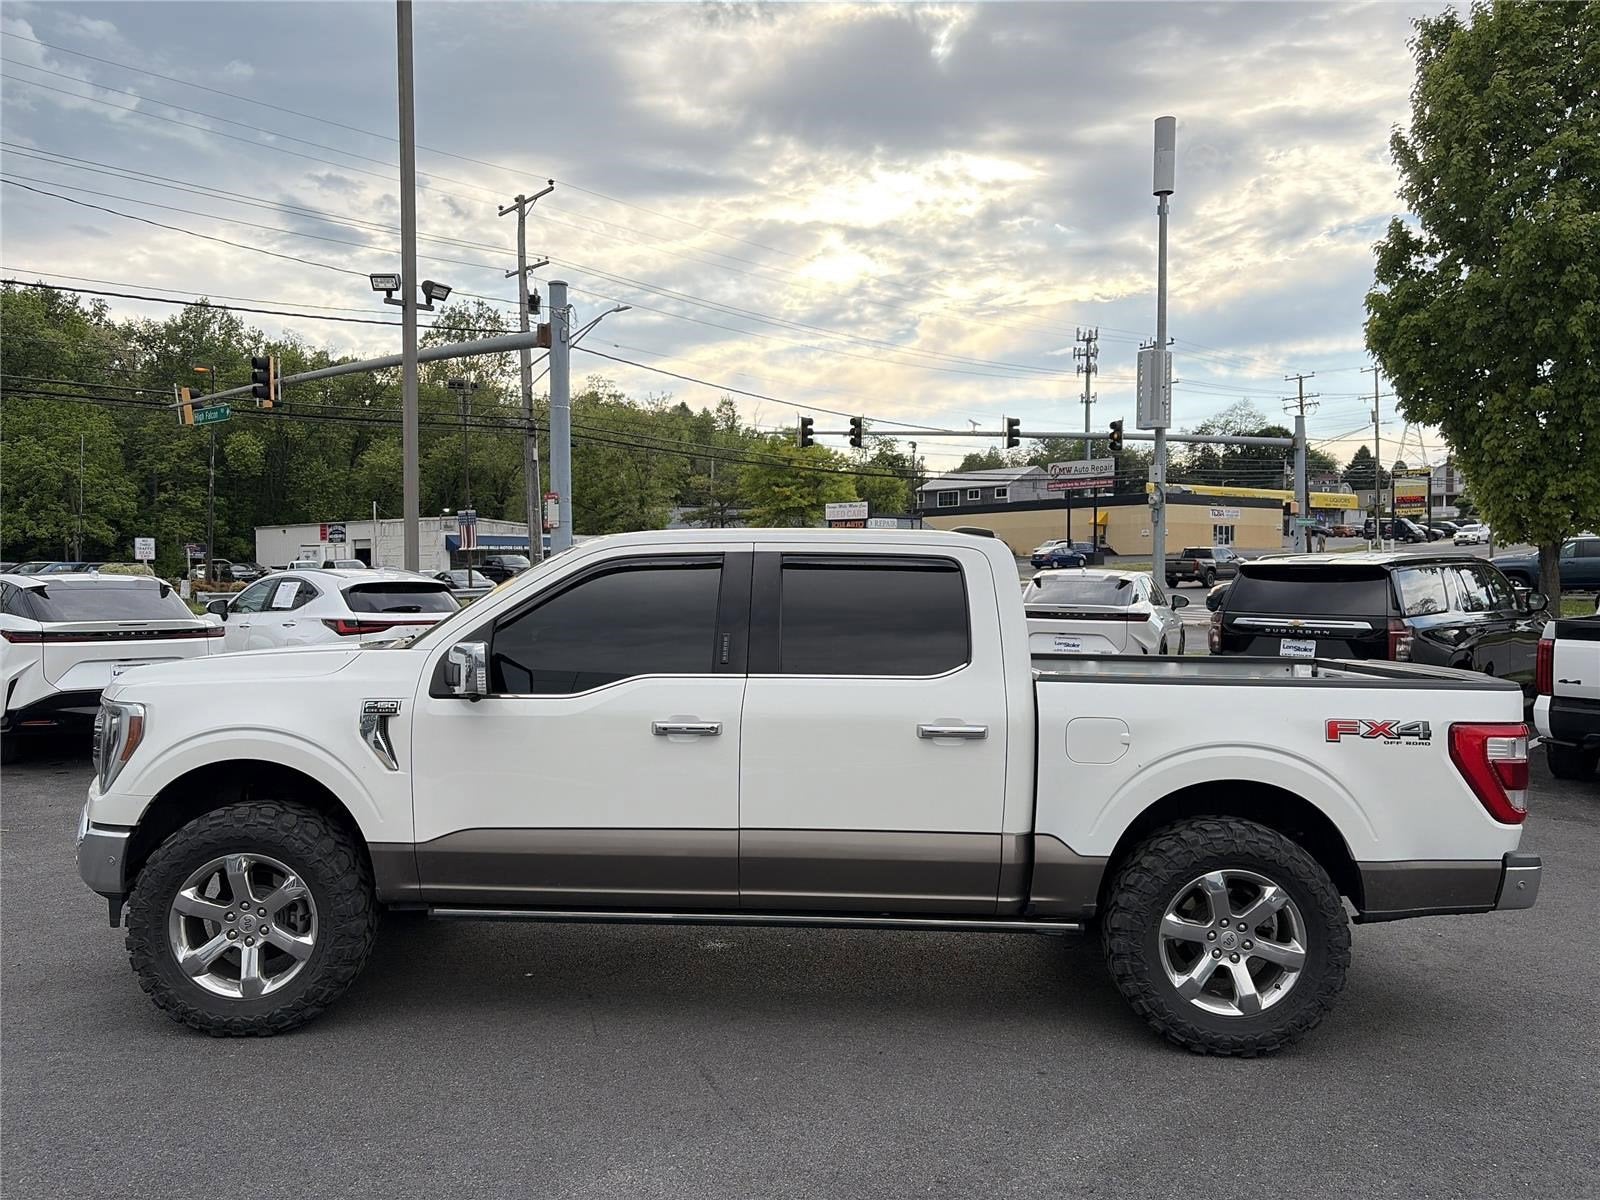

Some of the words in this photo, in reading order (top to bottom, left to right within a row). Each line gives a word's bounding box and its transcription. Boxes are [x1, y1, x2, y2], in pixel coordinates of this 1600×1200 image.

[205, 410, 219, 420] Falcon
[1073, 465, 1089, 473] Auto
[1090, 464, 1113, 473] Repair
[827, 510, 846, 518] USED
[846, 509, 867, 518] CARS
[874, 519, 897, 528] REPAIR
[1325, 718, 1432, 743] FX4
